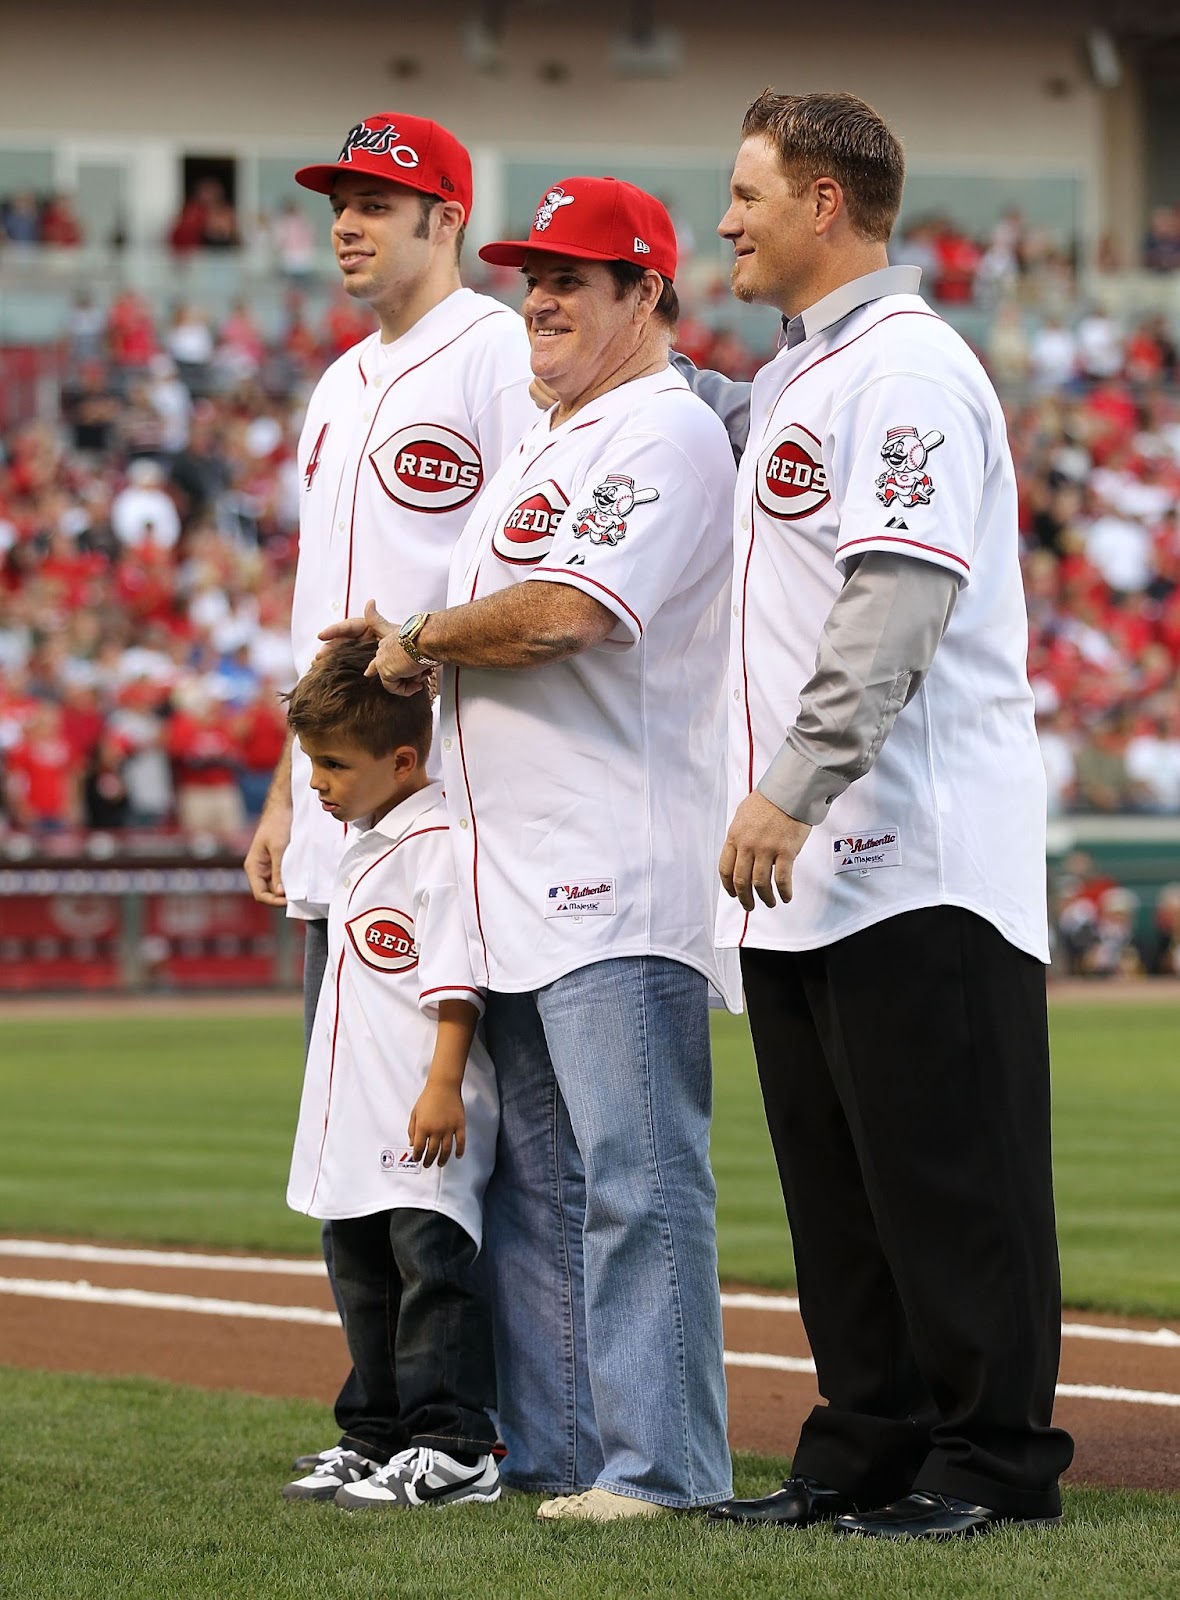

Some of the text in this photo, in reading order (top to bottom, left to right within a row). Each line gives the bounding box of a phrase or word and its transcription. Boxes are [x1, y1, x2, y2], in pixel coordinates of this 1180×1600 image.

[337, 122, 400, 164] Reds
[397, 452, 480, 487] REDS
[767, 456, 829, 491] REDS
[851, 834, 895, 853] Authentic
[853, 855, 883, 863] Majestic
[567, 883, 612, 901] Authentic
[569, 903, 600, 911] Majestic
